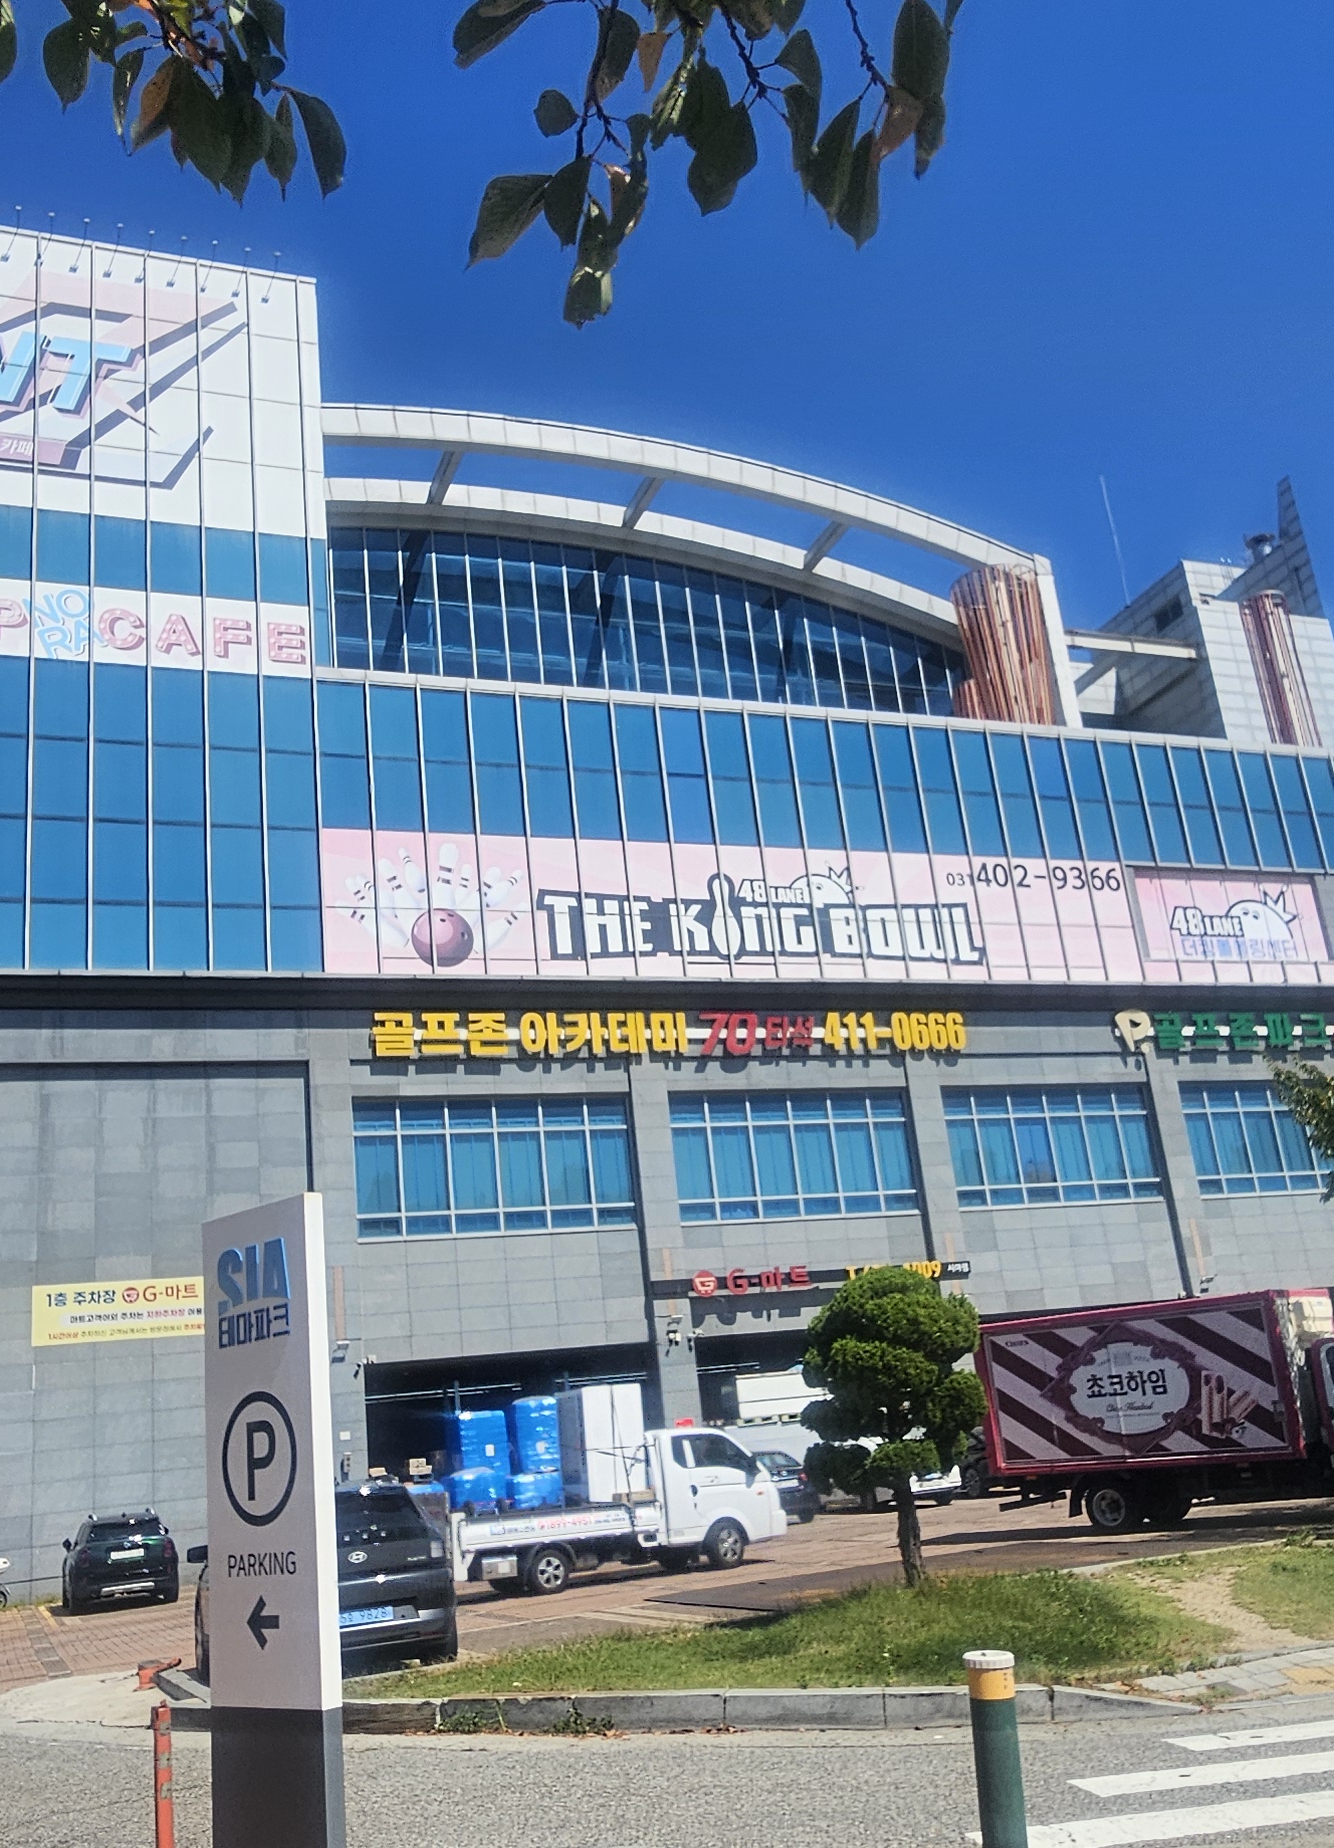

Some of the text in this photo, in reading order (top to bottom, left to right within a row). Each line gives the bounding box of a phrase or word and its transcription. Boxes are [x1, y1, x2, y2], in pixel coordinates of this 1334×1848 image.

[0, 437, 35, 457] 카페
[98, 608, 307, 665] CAFE
[737, 878, 767, 903] 48
[976, 862, 1121, 892] 402-9366
[542, 894, 654, 955] THE
[830, 906, 981, 962] BOWL
[1171, 906, 1245, 937] 48 LANE
[372, 1011, 966, 1057] 골프존 아카데미 70 타석 411-0666
[1153, 1010, 1333, 1051] 골프존파크
[217, 1236, 291, 1316] SIA
[726, 1265, 812, 1296] G-마트
[45, 1283, 200, 1308] 1층 주차장 G-마트
[218, 1302, 291, 1349] 테마파크
[1085, 1368, 1169, 1399] 초코하임
[227, 1551, 297, 1578] PARKING
